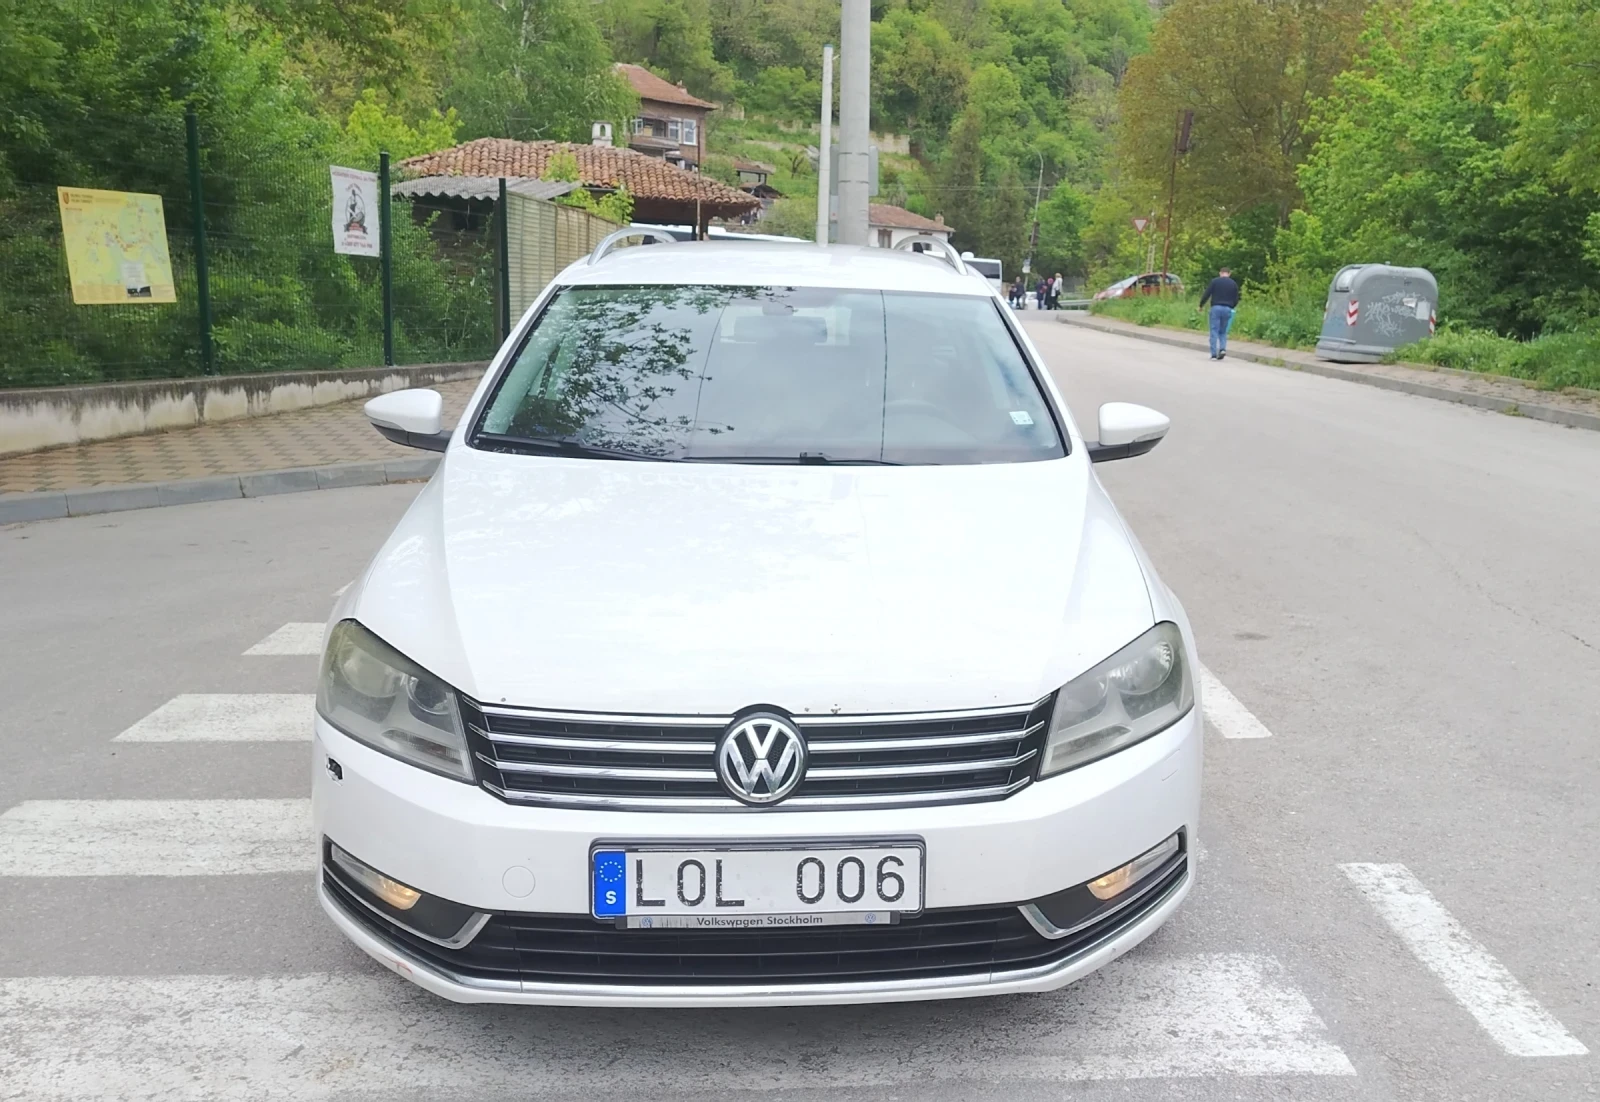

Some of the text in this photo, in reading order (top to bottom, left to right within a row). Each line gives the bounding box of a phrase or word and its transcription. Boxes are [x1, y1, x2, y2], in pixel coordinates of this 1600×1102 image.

[720, 717, 803, 803] VW
[605, 890, 617, 905] S
[636, 855, 905, 907] LOL 006
[696, 914, 823, 928] Volkswagen Stockholm
